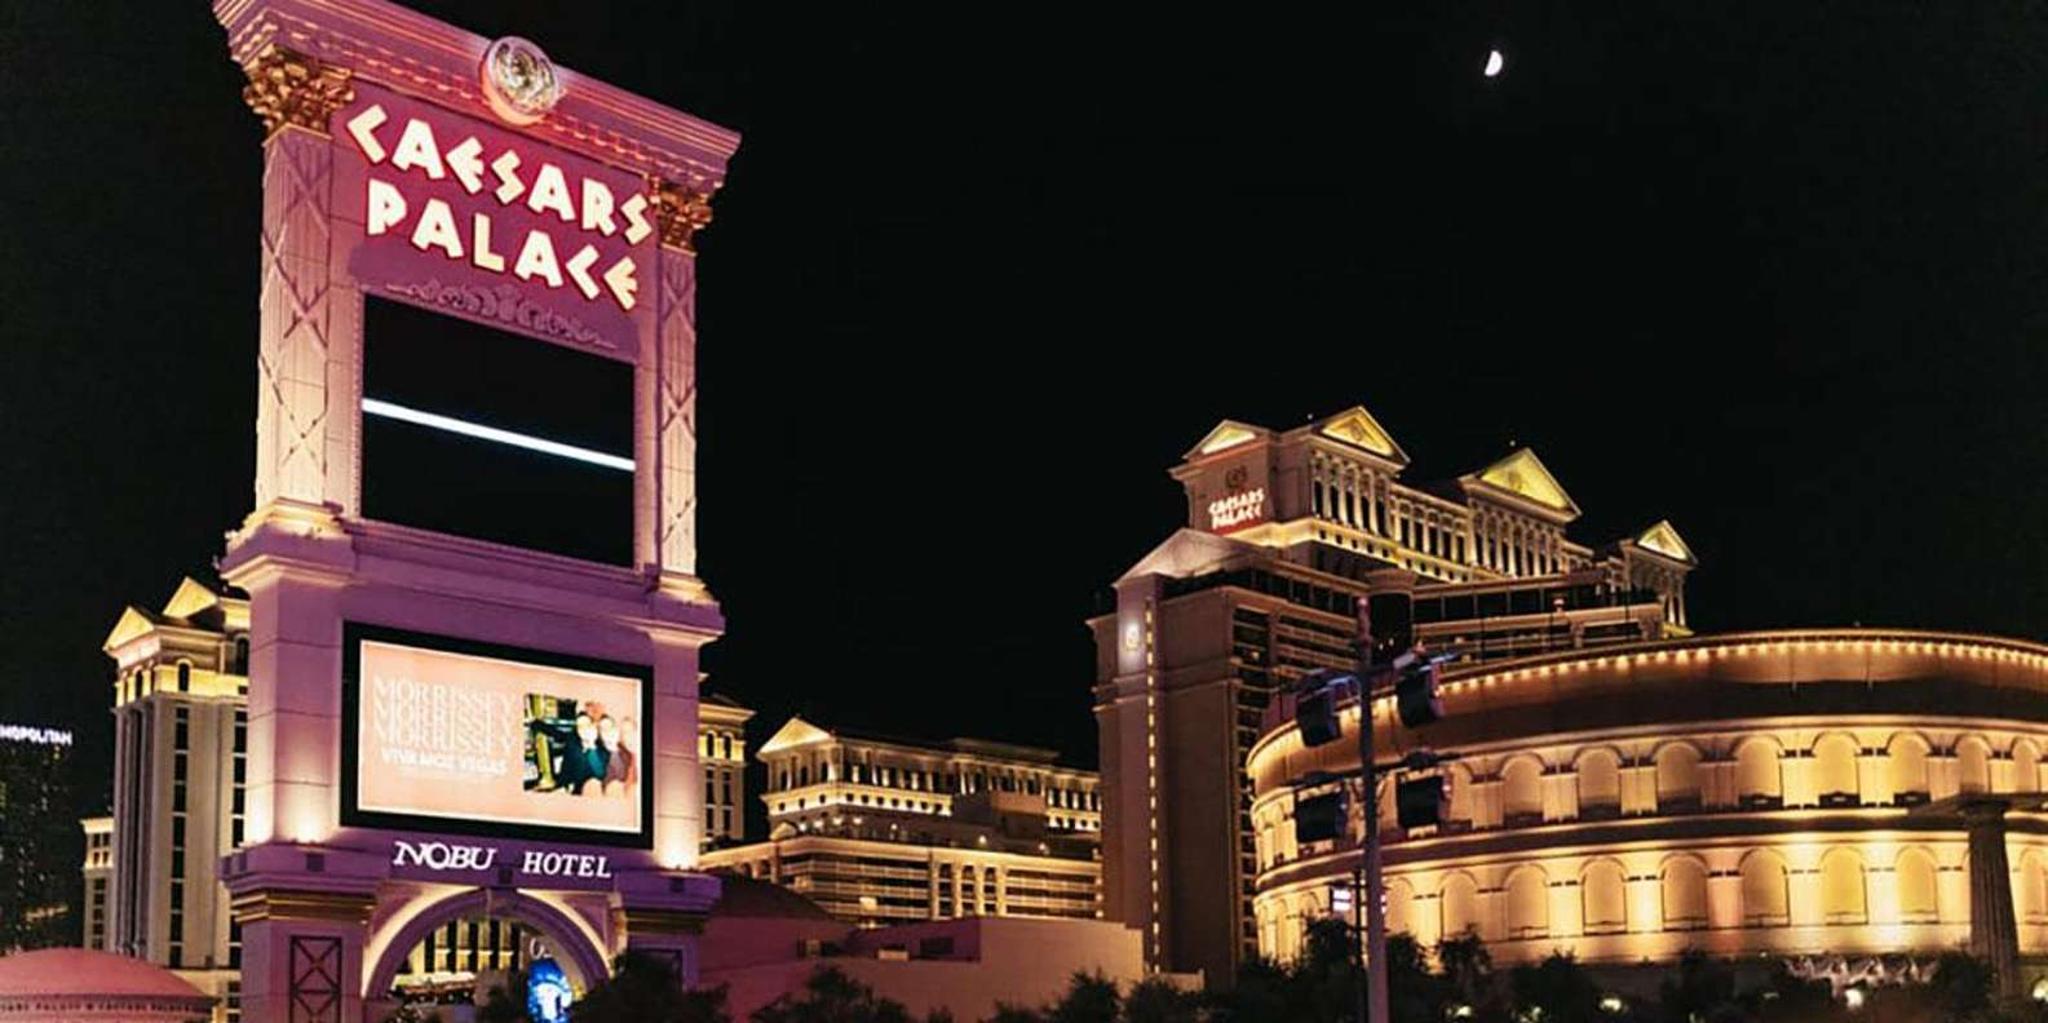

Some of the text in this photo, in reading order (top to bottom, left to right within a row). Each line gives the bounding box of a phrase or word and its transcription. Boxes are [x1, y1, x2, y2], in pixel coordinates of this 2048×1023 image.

[346, 103, 653, 246] CAESARS
[366, 178, 639, 311] PALACE
[1208, 487, 1265, 515] CAESARS
[1211, 503, 1263, 530] PALACE
[373, 675, 512, 717] MORRISSEY
[392, 840, 613, 879] NOBU HOTEL
